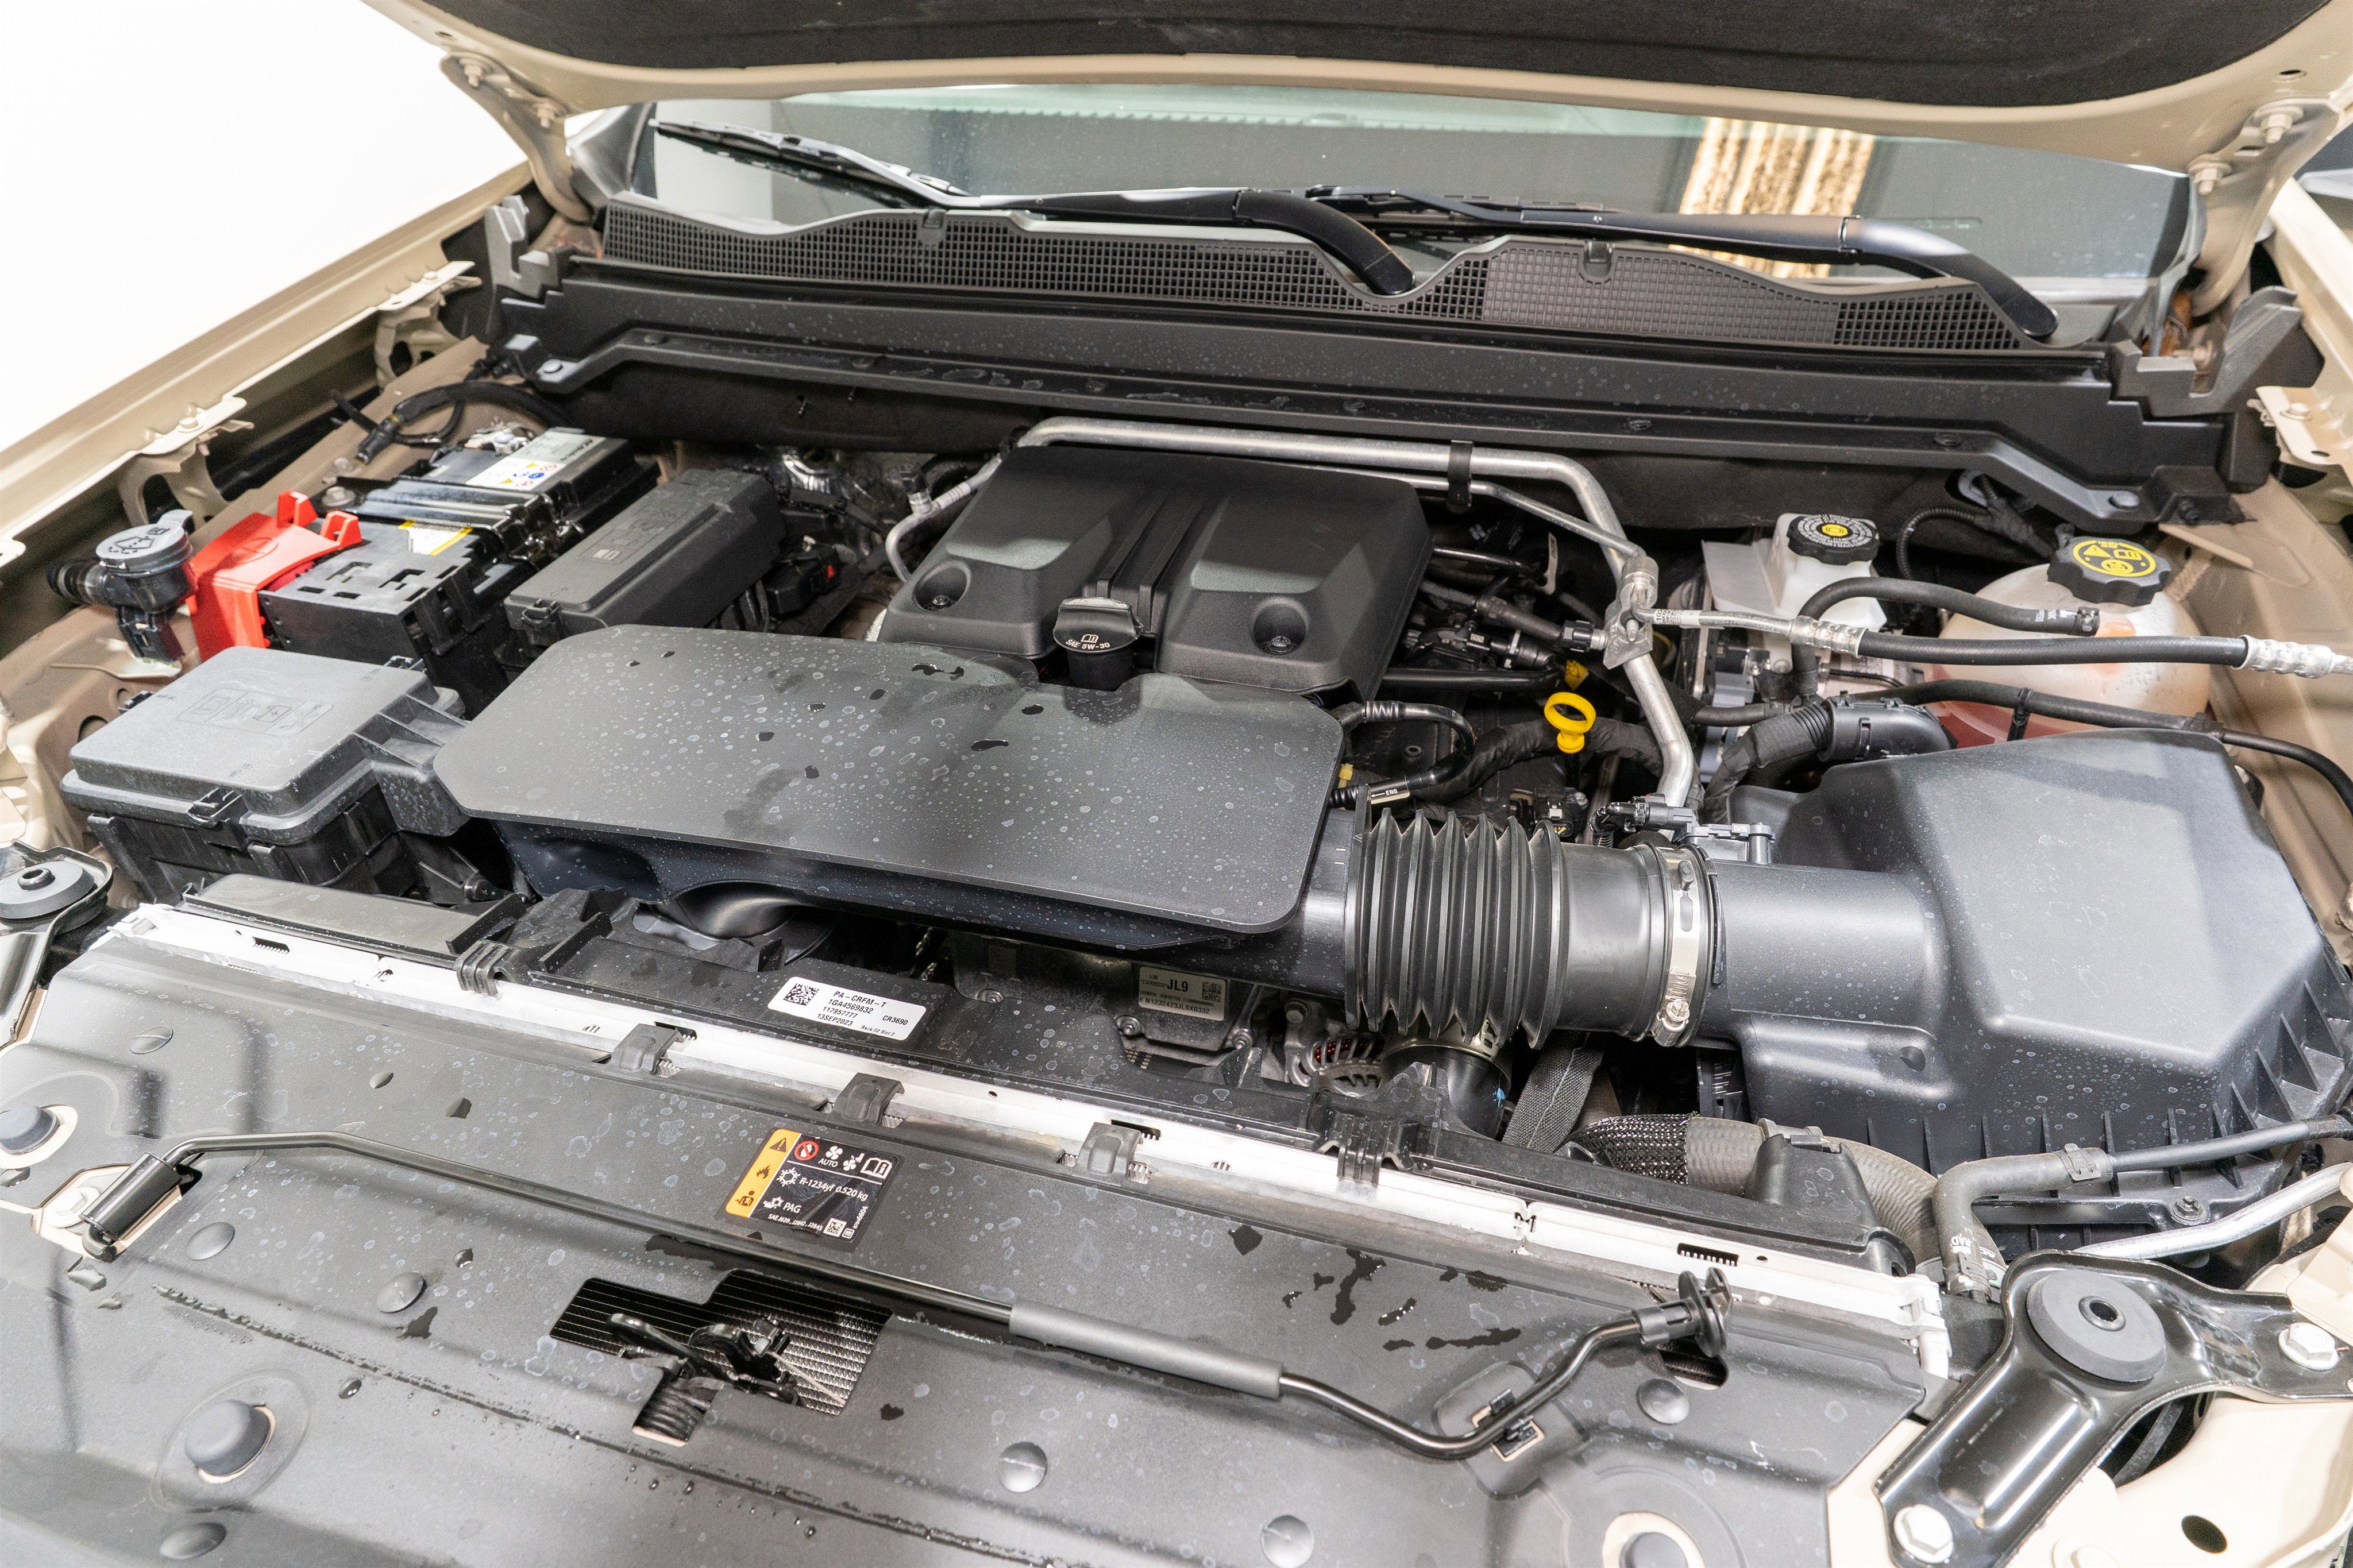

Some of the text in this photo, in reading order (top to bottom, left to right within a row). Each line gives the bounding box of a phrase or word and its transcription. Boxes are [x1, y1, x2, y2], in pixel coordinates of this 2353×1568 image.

[1065, 639, 1111, 650] SAE 5W-30
[1385, 788, 1398, 796] ENG
[1167, 979, 1189, 992] JL9
[822, 1005, 859, 1019] 117957777
[828, 998, 874, 1014] 1GA4569832
[816, 1013, 854, 1027] 13SEP2023
[882, 1014, 909, 1026] CR3690
[817, 1158, 838, 1168] AUTO
[799, 1177, 869, 1202] R-1234yf 0.520 kg
[782, 1202, 802, 1214] PAG
[767, 1212, 779, 1222] SAE
[807, 1222, 824, 1231] J2845
